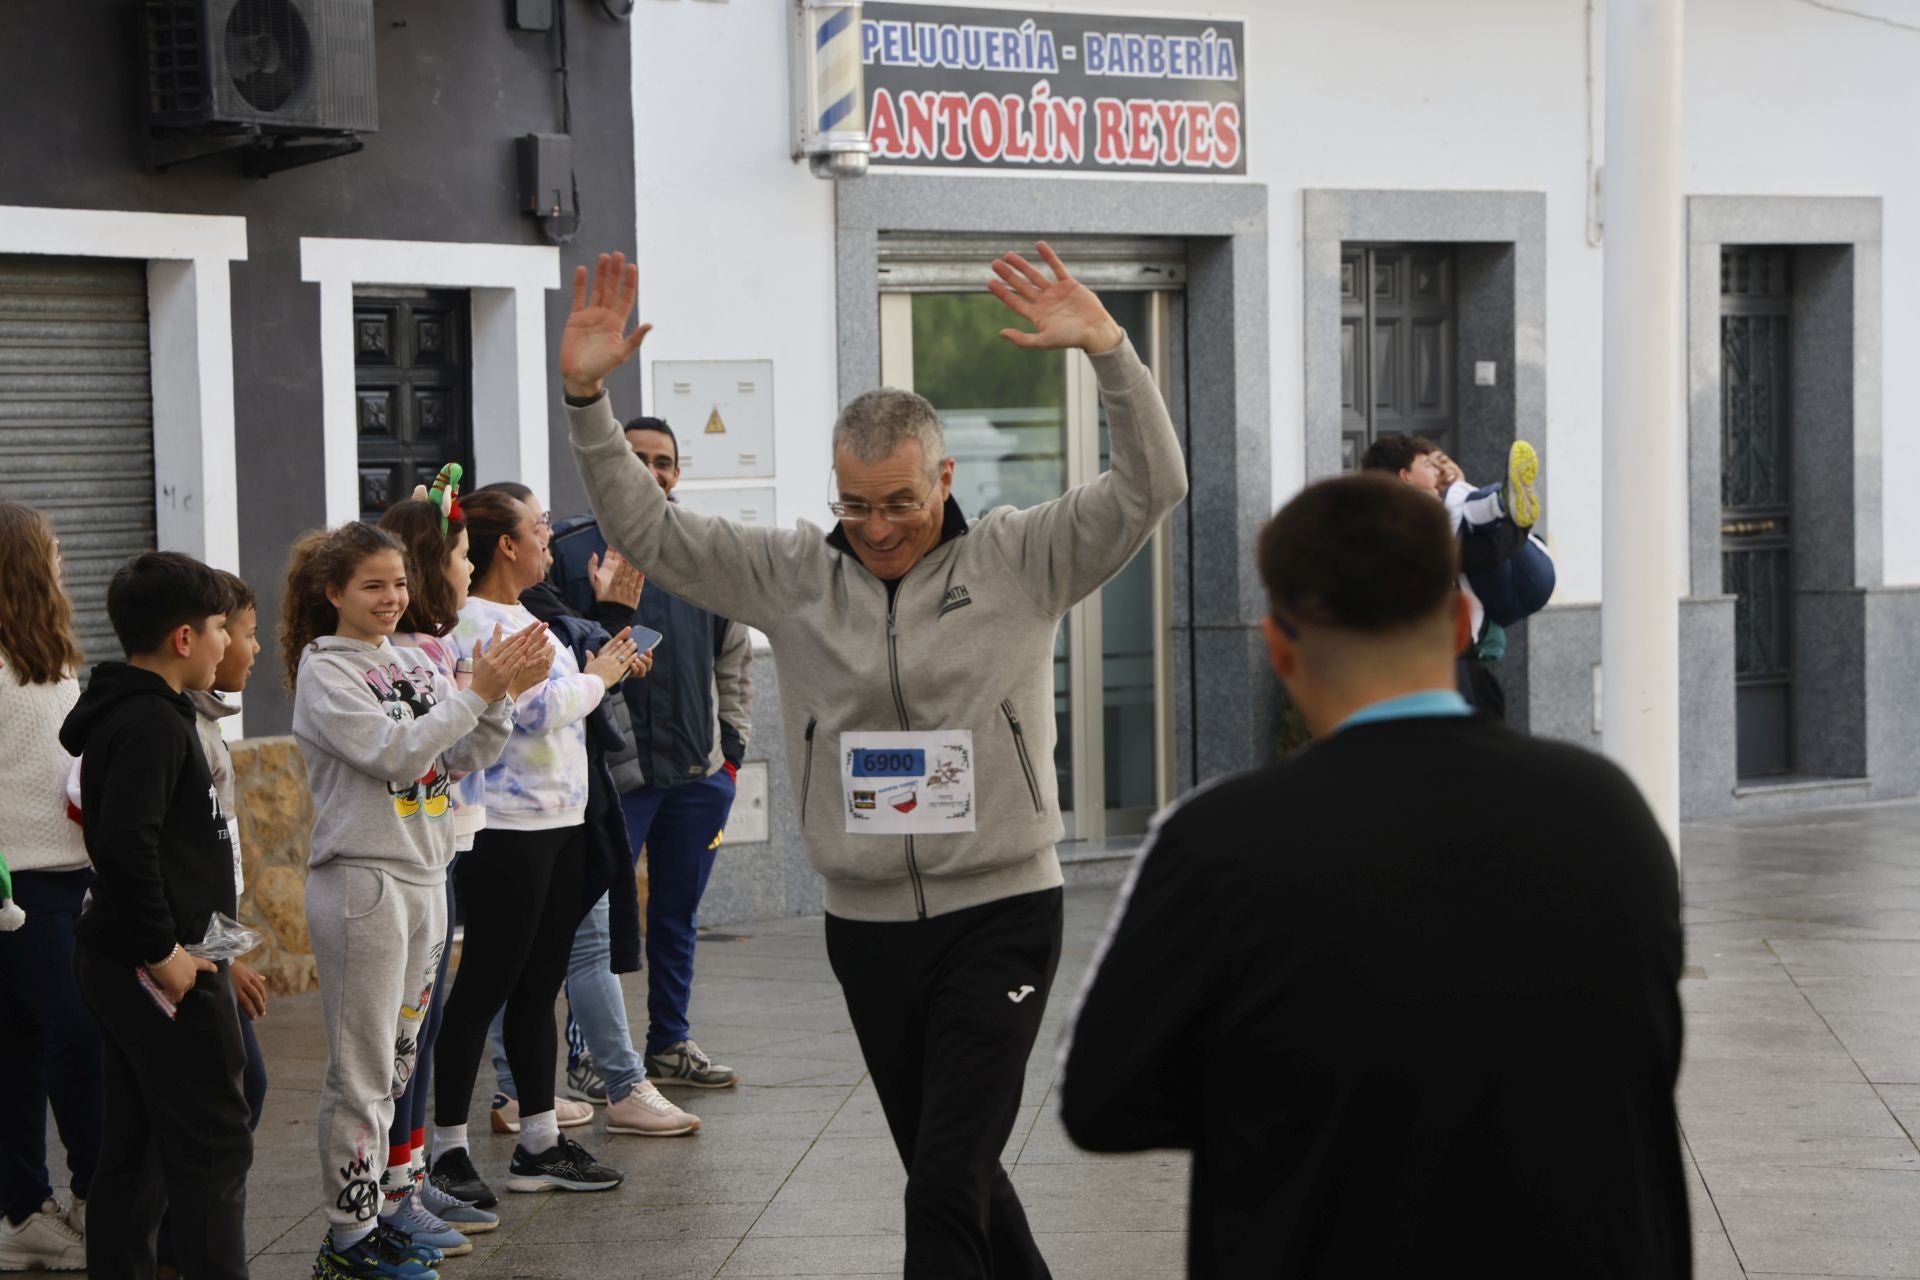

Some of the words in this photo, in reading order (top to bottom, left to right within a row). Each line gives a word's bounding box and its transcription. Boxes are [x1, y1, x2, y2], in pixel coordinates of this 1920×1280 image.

[861, 18, 1058, 73] PELUQUERÍA
[1083, 28, 1237, 80] BARBERÍA
[868, 80, 1085, 163] ANTOLÍN
[1094, 97, 1240, 167] REYES
[863, 752, 914, 772] 6900
